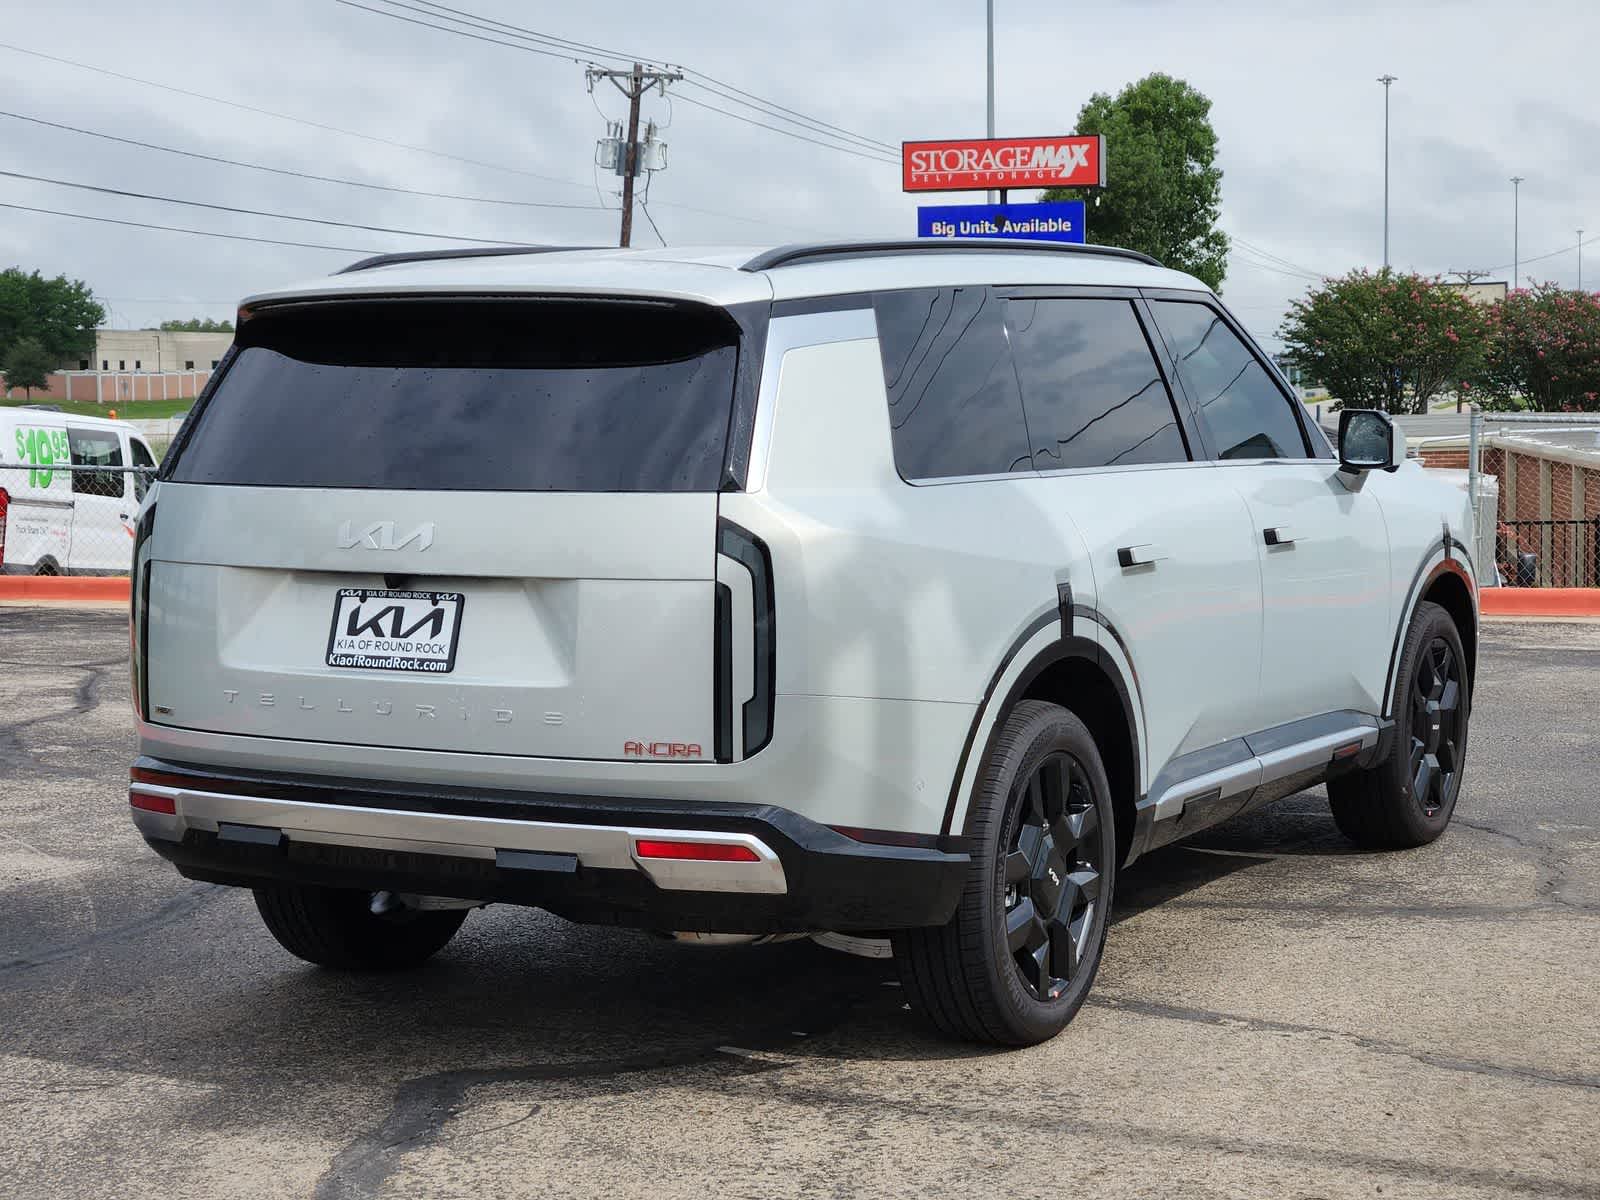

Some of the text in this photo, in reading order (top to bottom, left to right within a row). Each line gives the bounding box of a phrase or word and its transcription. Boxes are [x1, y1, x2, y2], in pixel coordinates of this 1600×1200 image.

[972, 170, 1057, 181] STORAGE
[931, 217, 1072, 237] Big Units Available
[337, 519, 435, 552] KIA
[340, 589, 362, 597] KIA
[388, 591, 412, 599] ROUND
[436, 593, 457, 601] KIA
[346, 603, 445, 640] KIA
[336, 639, 446, 655] KIA OF ROUND ROCK
[328, 653, 447, 672] KiaofRoundRock.com
[223, 689, 568, 726] TELLURIDE
[623, 740, 703, 758] ANCIRA
